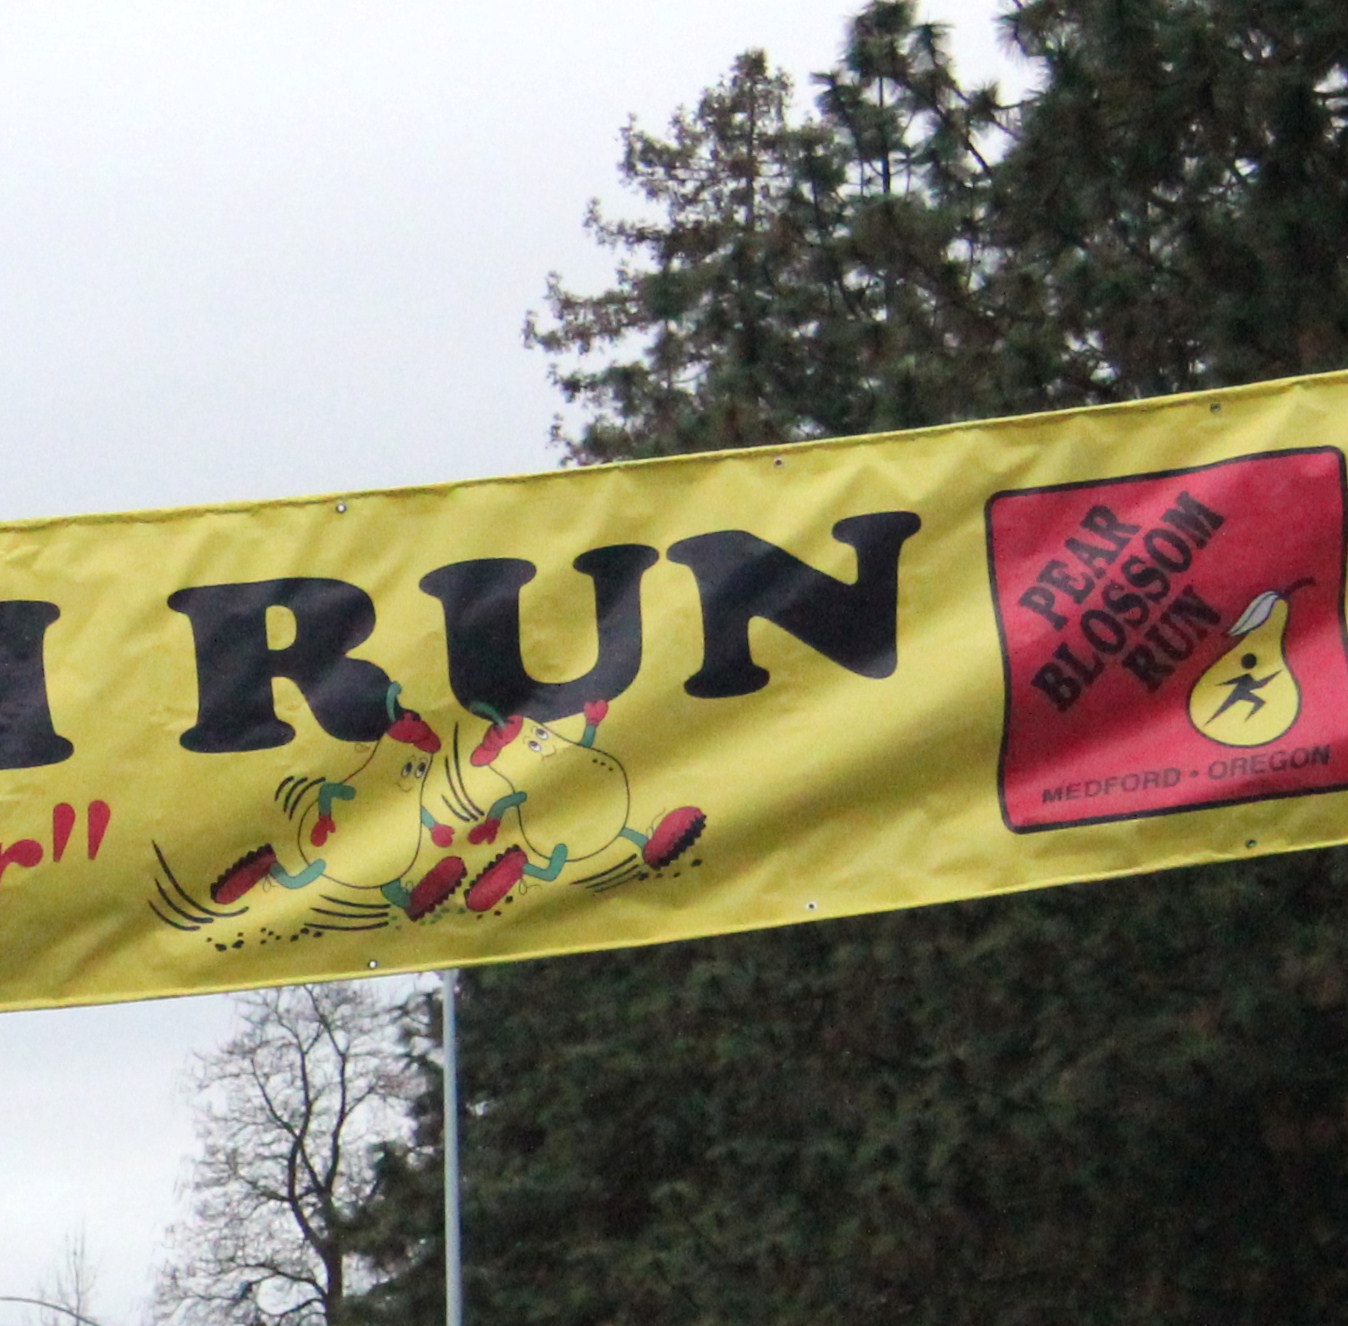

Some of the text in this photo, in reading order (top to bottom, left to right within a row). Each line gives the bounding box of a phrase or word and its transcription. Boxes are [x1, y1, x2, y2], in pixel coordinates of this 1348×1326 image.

[1019, 504, 1142, 631] PEAR
[1031, 491, 1225, 712] BLOSSOM
[167, 510, 923, 754] RUN
[1122, 584, 1222, 692] RUN
[1042, 744, 1331, 803] MEDFORD OREGON
